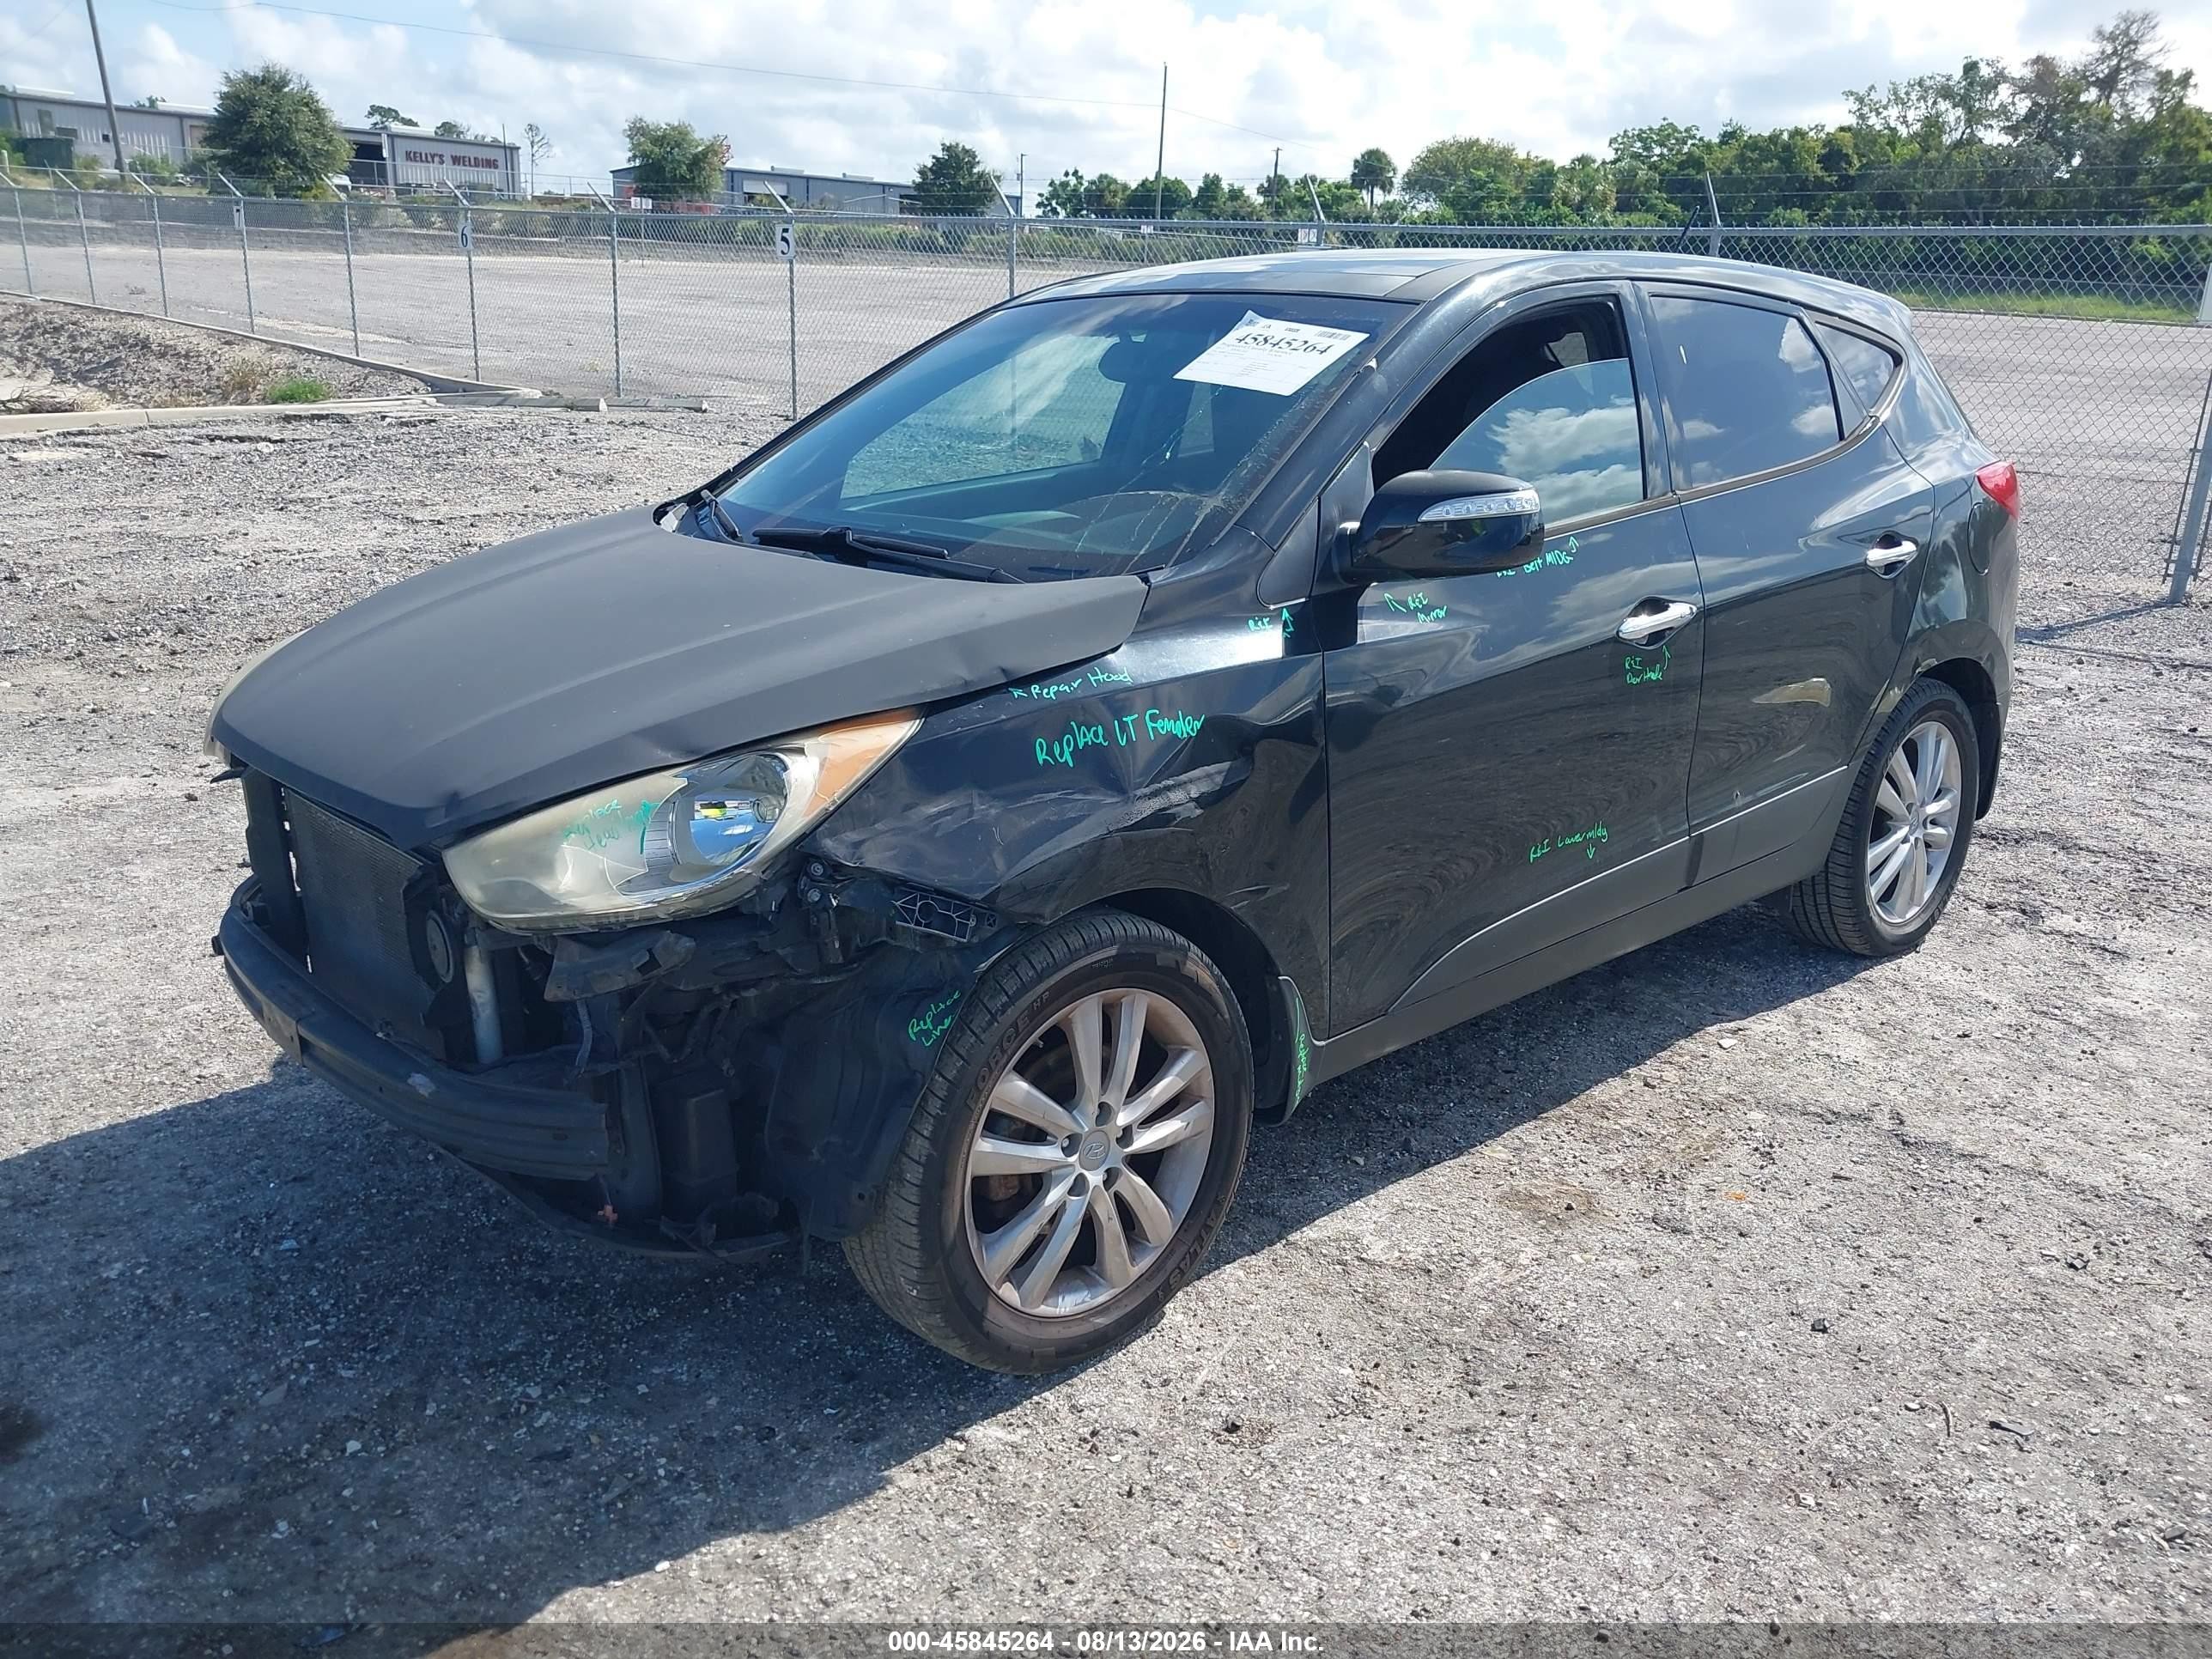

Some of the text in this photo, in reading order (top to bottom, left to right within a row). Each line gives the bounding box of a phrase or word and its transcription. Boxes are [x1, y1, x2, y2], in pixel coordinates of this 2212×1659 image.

[405, 150, 499, 169] KELLY'S WELDING
[460, 225, 468, 248] 6
[780, 228, 790, 255] 5
[1235, 332, 1335, 356] 45845264
[1030, 666, 1133, 700] Repair Hood
[1145, 708, 1205, 741] Fender
[966, 991, 1050, 1113] FORCE HP
